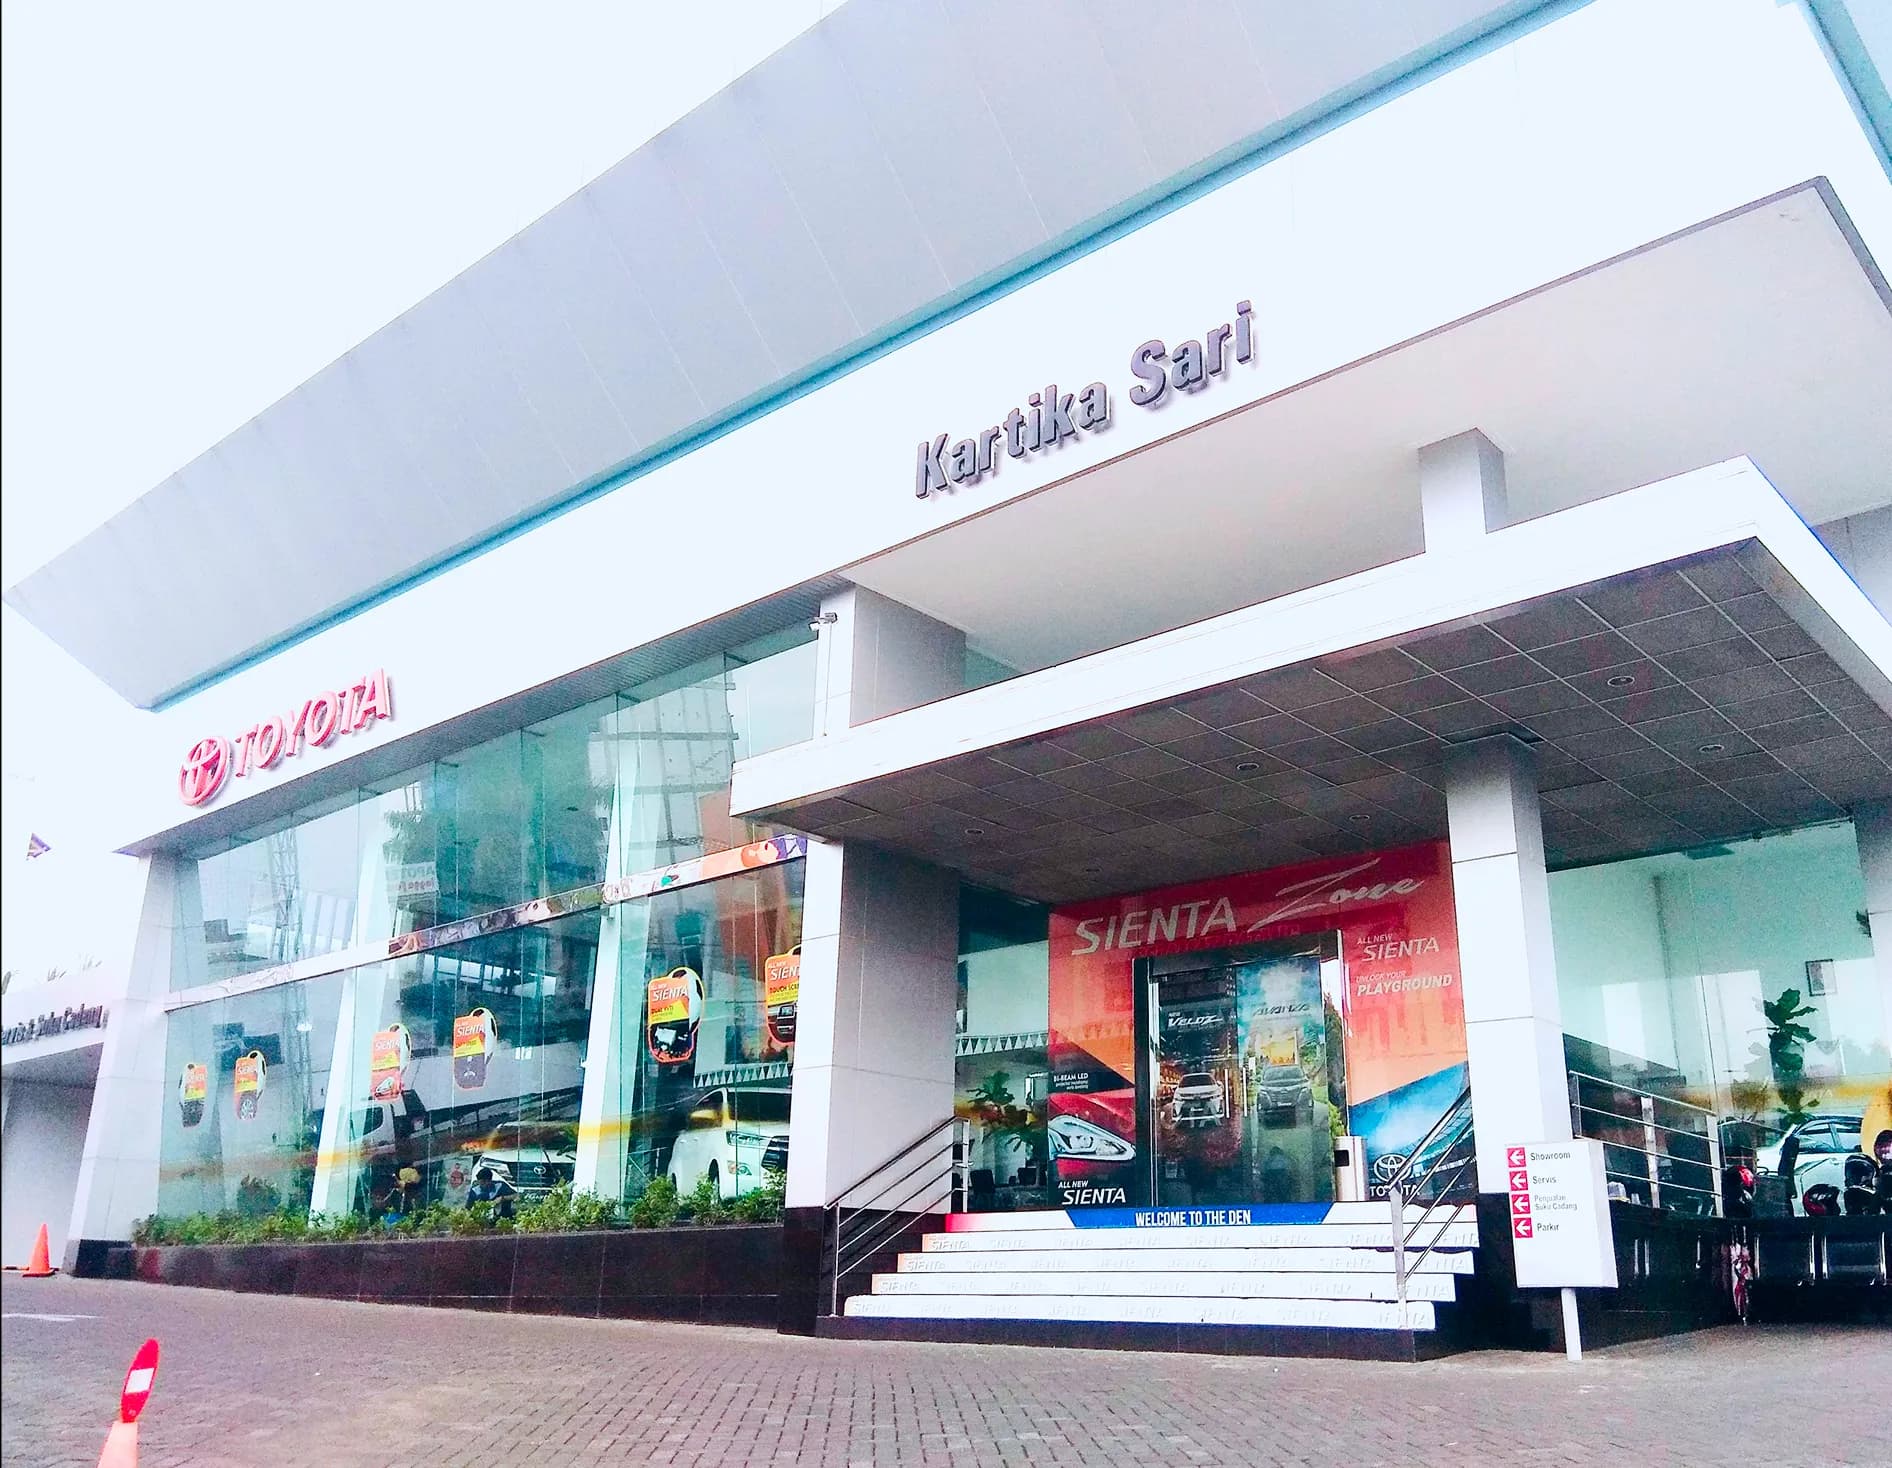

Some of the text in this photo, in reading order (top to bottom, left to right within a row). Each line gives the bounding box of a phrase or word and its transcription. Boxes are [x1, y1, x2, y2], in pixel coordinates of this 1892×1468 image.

[915, 300, 1253, 499] Kartika Sari
[234, 668, 392, 778] TOYOTA
[1071, 897, 1237, 955] SIENTA
[1247, 857, 1425, 933] Zone
[1357, 933, 1393, 945] ALL NEW
[1361, 937, 1440, 961] SIENTA
[653, 984, 688, 1001] SIENTA
[1357, 974, 1453, 997] PLAYGROUND
[456, 1025, 485, 1037] SIENTA
[1530, 1152, 1571, 1161] Showroom
[1058, 1180, 1088, 1189] ALL NEW
[1532, 1176, 1557, 1184] Servis
[1061, 1188, 1126, 1205] SIENTA
[1135, 1210, 1251, 1226] WELCOME TO THE DEN
[1537, 1223, 1559, 1231] Parkir
